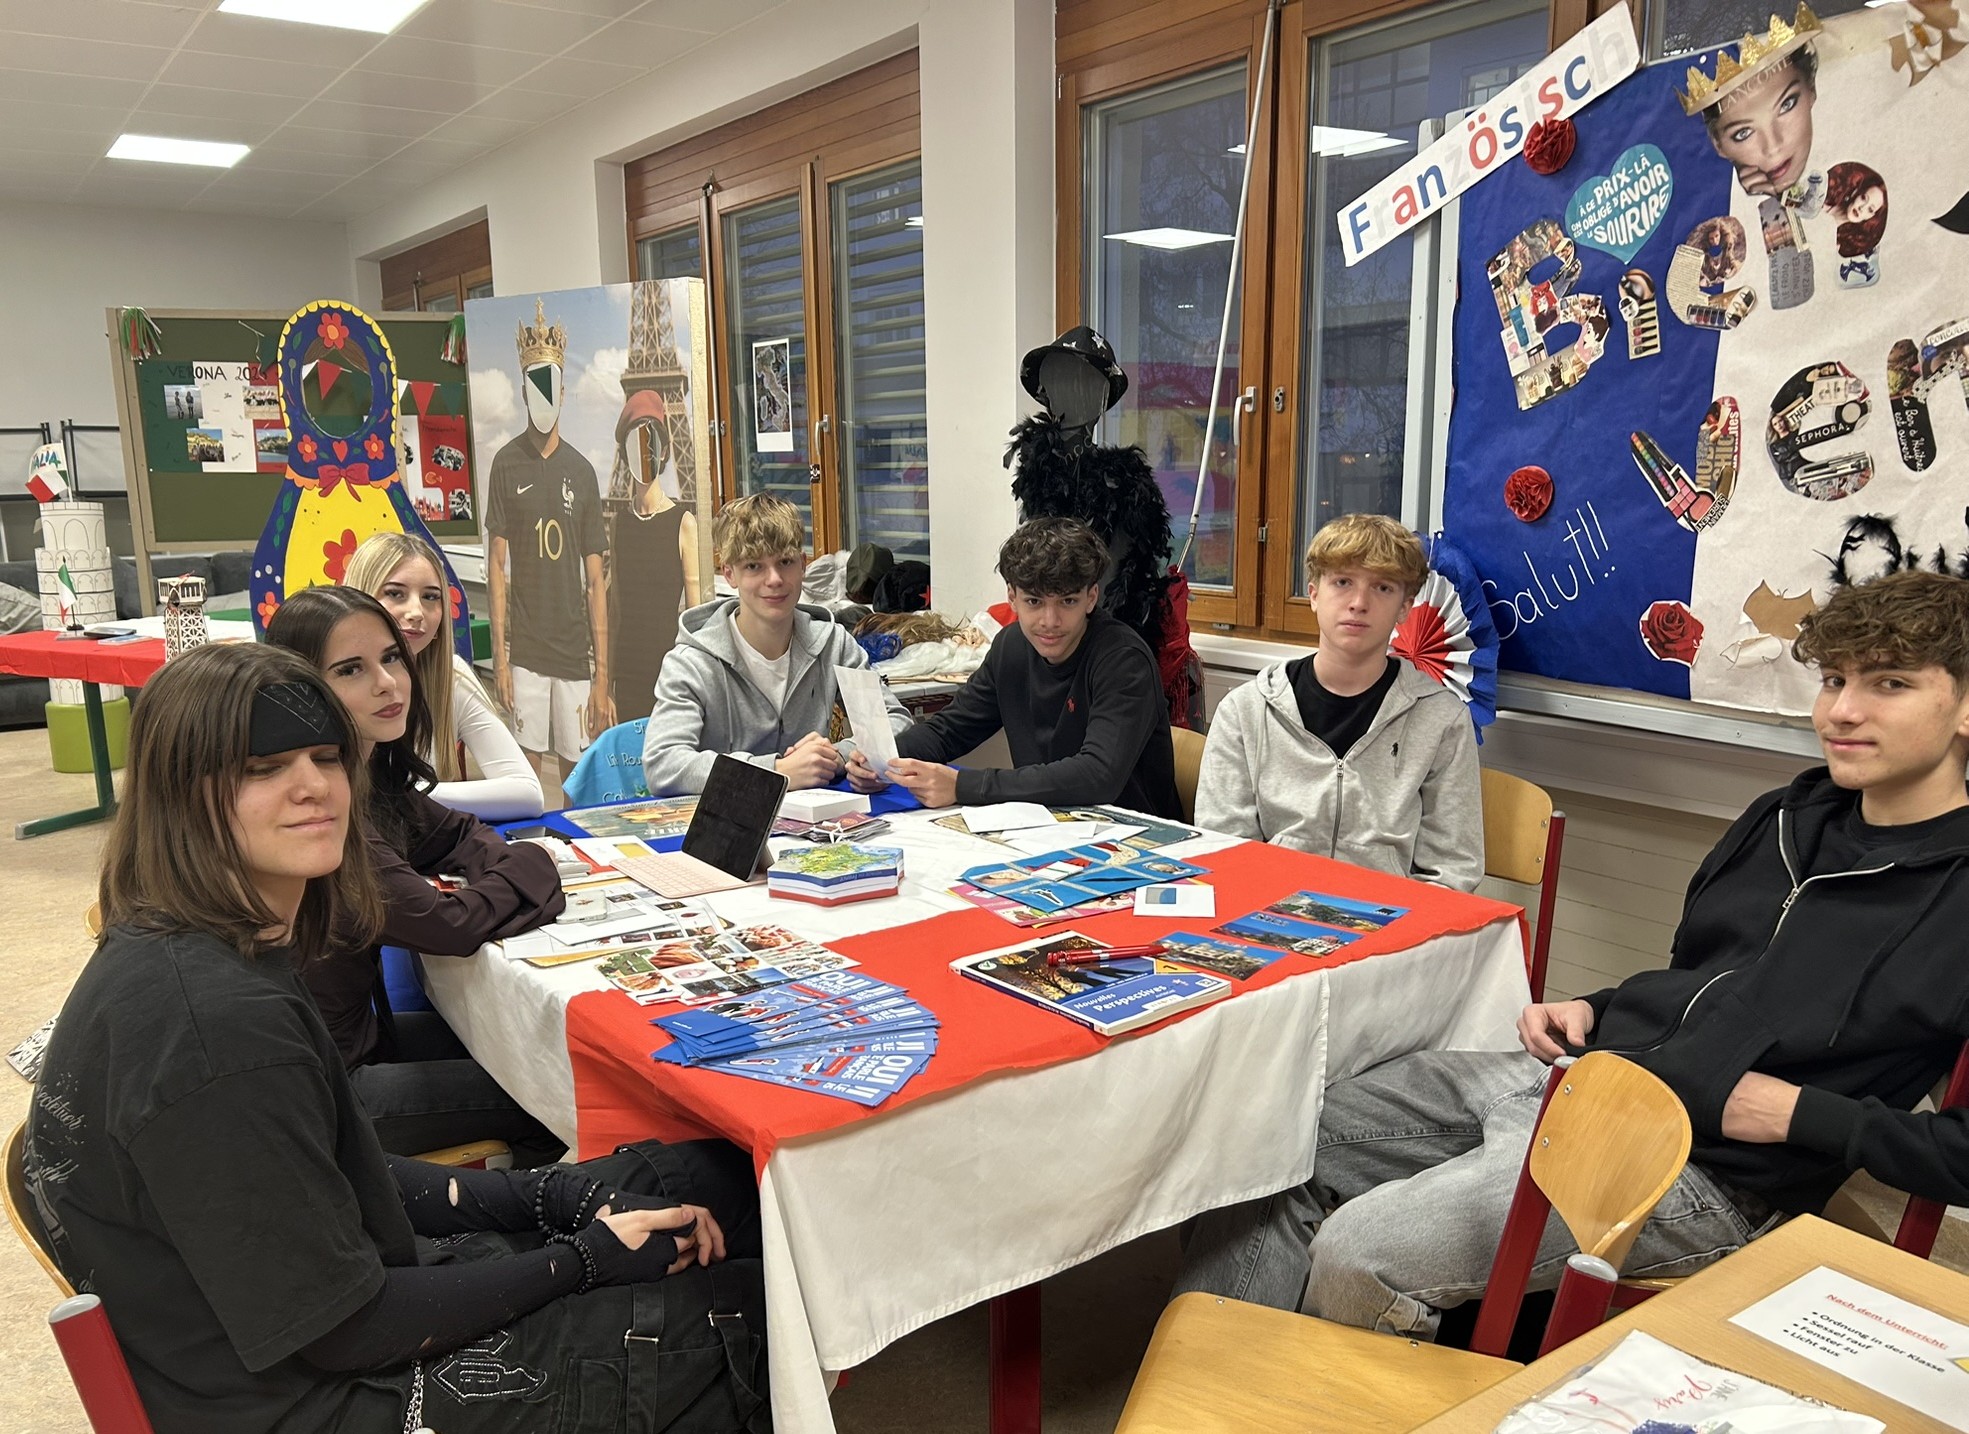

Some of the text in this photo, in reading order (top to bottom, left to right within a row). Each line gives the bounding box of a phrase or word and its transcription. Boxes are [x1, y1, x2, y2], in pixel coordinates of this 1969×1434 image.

[1349, 26, 1630, 254] Französisch
[1593, 183, 1670, 246] SOURIRE
[167, 365, 228, 381] VERONA
[1795, 422, 1845, 445] SEPHORA
[534, 517, 564, 561] 10
[820, 971, 872, 990] OUI
[1073, 993, 1117, 1010] Nouvelles
[1092, 984, 1168, 1012] Perspectives
[865, 1055, 914, 1086] OUI
[1826, 1294, 1856, 1310] Nach
[1857, 1307, 1883, 1322] dem
[1790, 1332, 1841, 1358] Licht aus
[1800, 1326, 1859, 1355] Fenster zu
[1809, 1319, 1874, 1350] Sessel rauf
[1819, 1314, 1945, 1373] Ordnung in der Klasse
